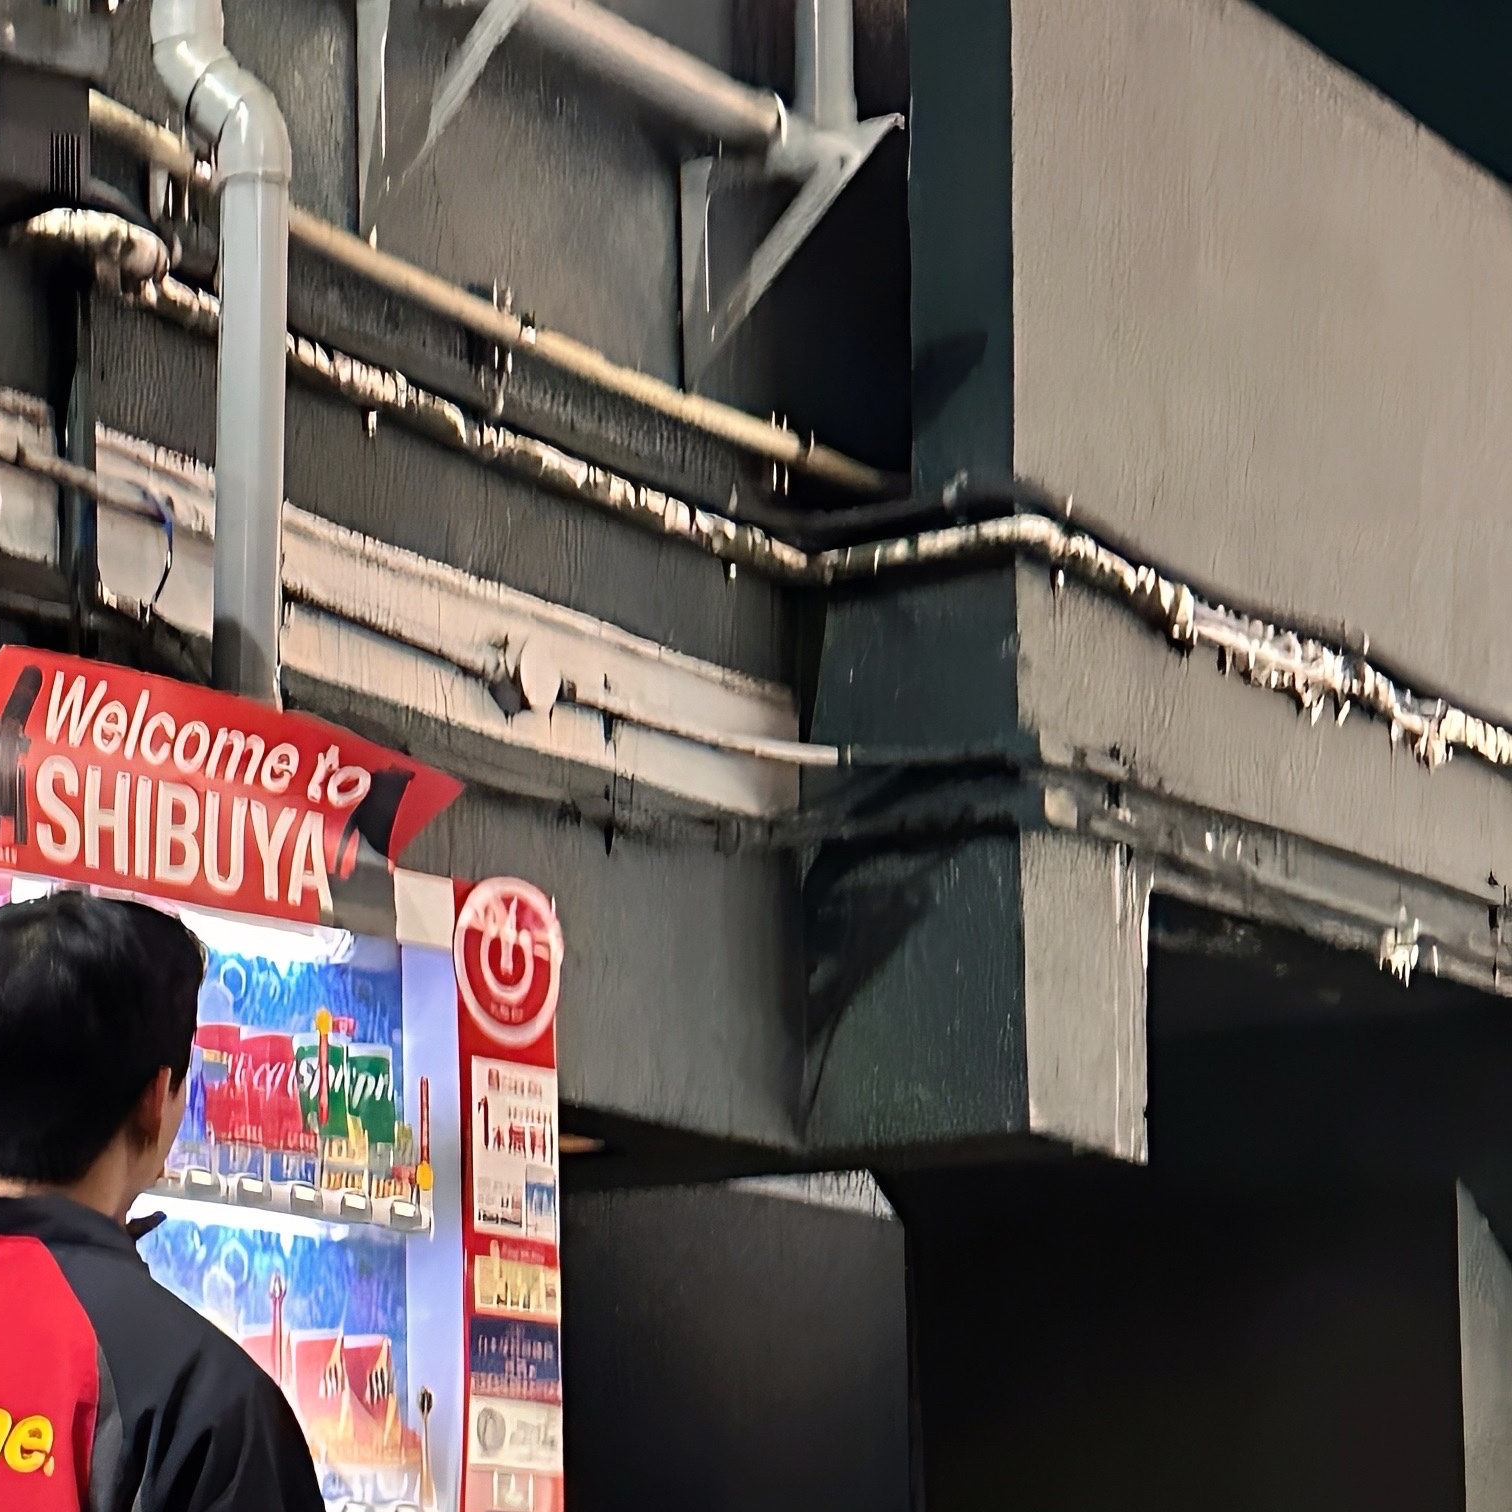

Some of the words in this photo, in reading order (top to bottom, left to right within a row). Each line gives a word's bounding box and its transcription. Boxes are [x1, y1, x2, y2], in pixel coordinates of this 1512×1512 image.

[45, 670, 299, 794] Welcome
[308, 745, 371, 807] to
[36, 755, 334, 920] SHIBUYA
